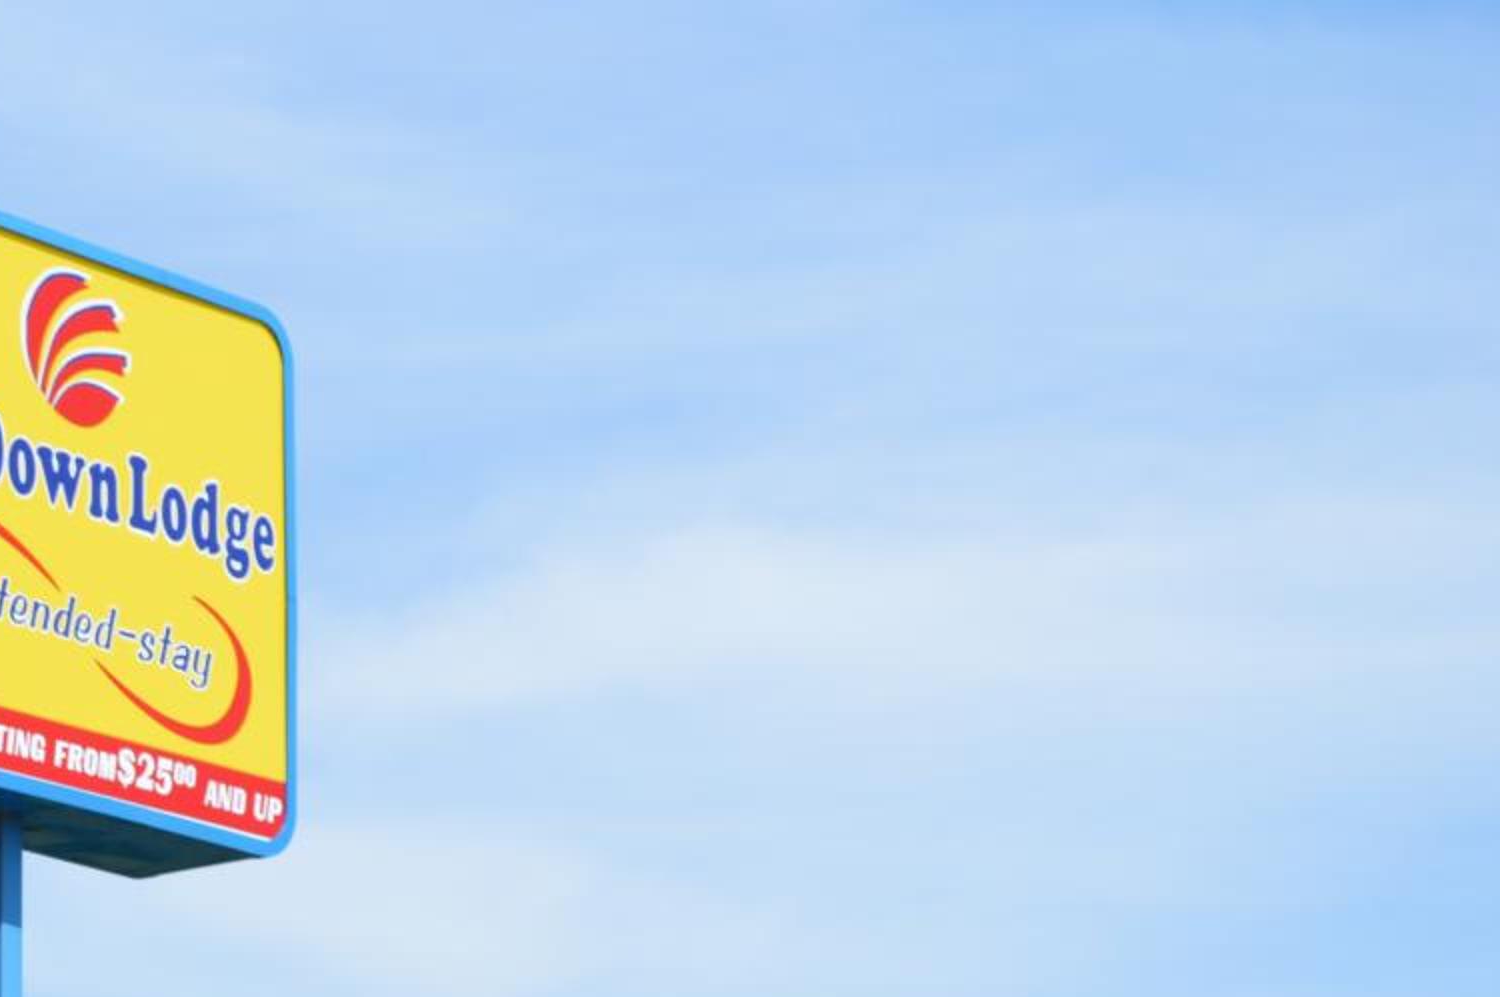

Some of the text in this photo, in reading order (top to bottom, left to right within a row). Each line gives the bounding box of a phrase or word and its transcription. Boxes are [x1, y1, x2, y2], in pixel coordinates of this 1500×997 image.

[53, 740, 117, 781] FROM
[203, 779, 246, 815] AND
[253, 792, 283, 824] UP
